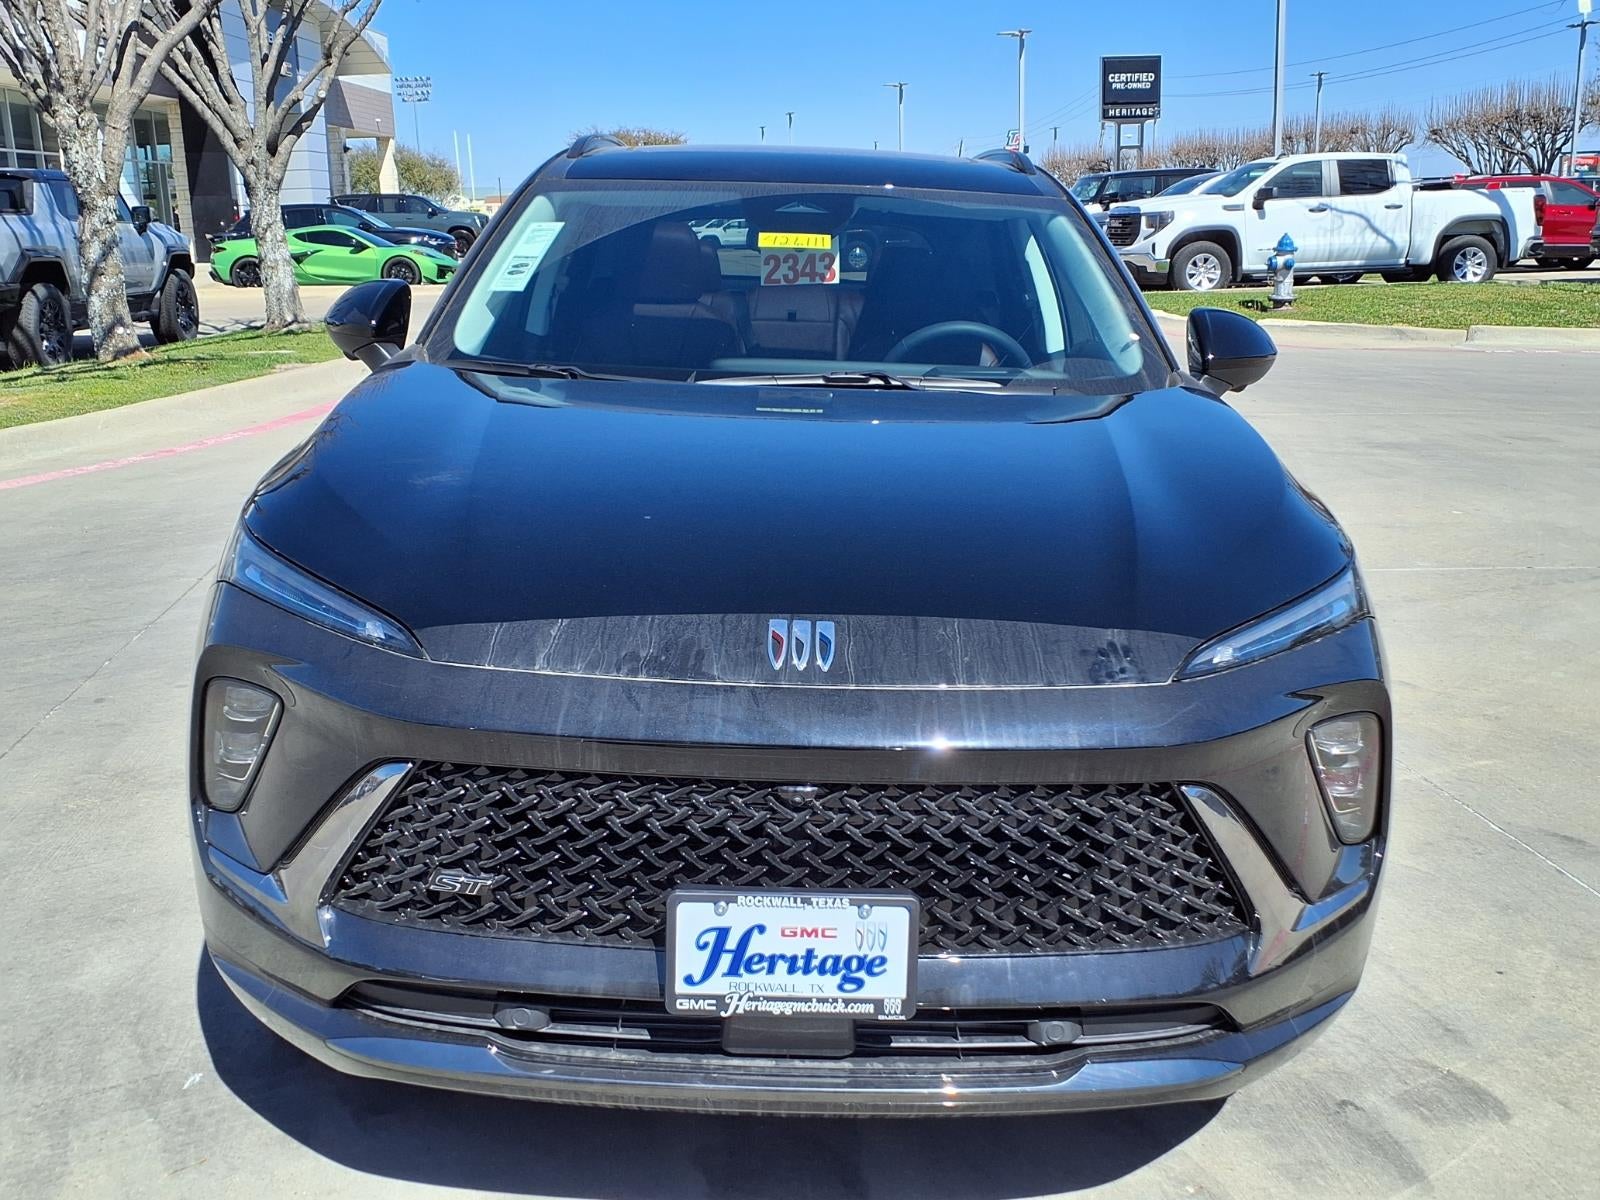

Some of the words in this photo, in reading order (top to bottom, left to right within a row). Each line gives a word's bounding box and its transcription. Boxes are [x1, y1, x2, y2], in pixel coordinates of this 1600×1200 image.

[1108, 72, 1155, 82] CERTIFIED
[1112, 82, 1151, 90] PRE-OWNED
[1108, 107, 1154, 117] HERITAGE
[763, 252, 836, 285] 2343
[430, 875, 492, 895] ST
[811, 897, 850, 909] TEXAS
[780, 927, 838, 939] GMC
[683, 924, 888, 993] Heritage
[809, 983, 825, 994] TX
[676, 998, 717, 1011] GMC
[720, 992, 875, 1017] Heritagegmcbuick.com
